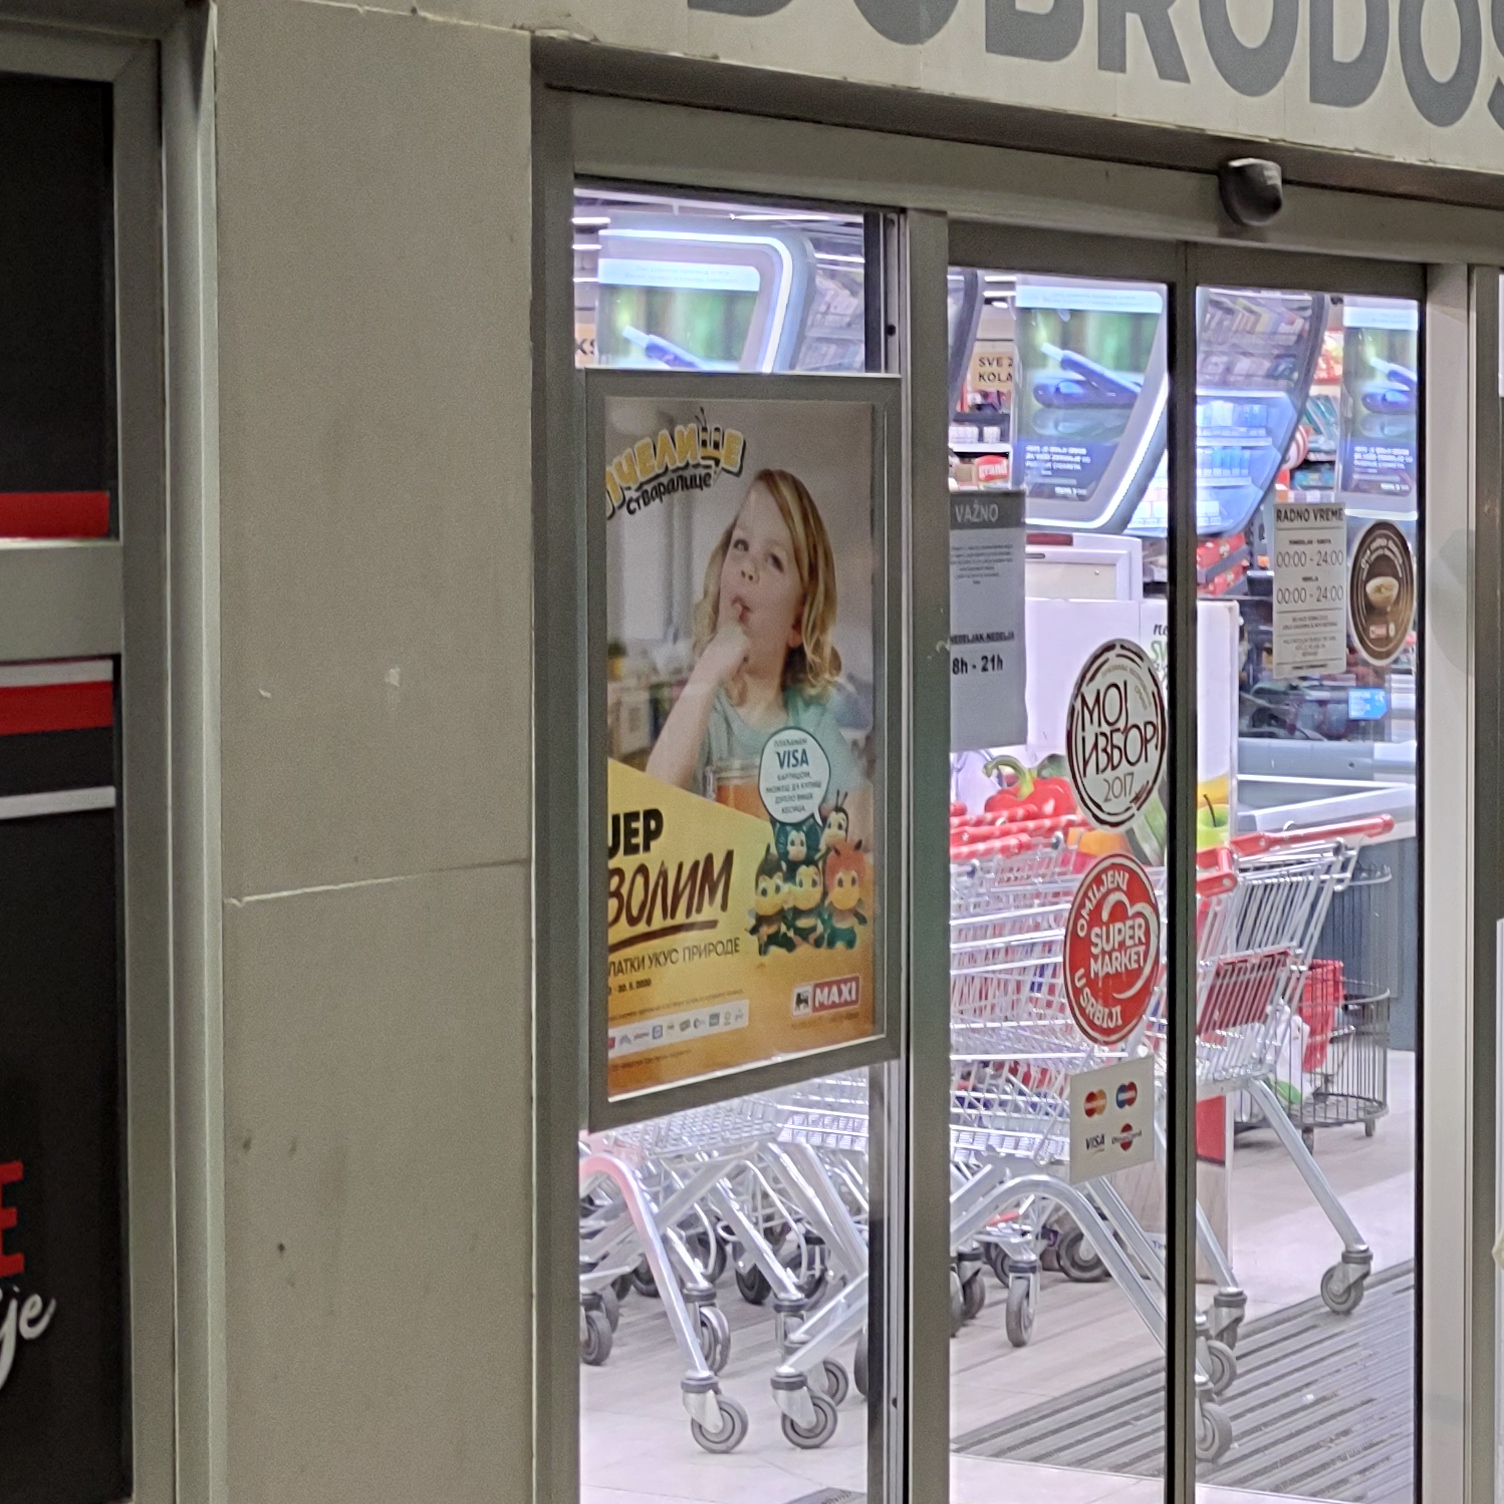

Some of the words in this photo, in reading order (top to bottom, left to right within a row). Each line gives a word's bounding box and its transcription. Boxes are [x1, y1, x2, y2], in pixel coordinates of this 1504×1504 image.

[978, 356, 1004, 368] SVE
[955, 499, 999, 523] VAŽNO
[1276, 507, 1310, 524] RADNO
[1313, 506, 1344, 522] VREME
[981, 653, 1003, 673] 21h
[775, 747, 809, 770] VISA
[1103, 772, 1134, 803] 2017
[1076, 869, 1129, 937] OMILJENI
[682, 936, 740, 962] ПРИРОДЕ
[1090, 917, 1146, 955] SUPER
[1090, 945, 1146, 980] MARKET
[814, 979, 857, 1008] MAXI
[1074, 968, 1086, 988] U
[1080, 990, 1123, 1029] SRBIJI
[1085, 1133, 1105, 1151] VISA
